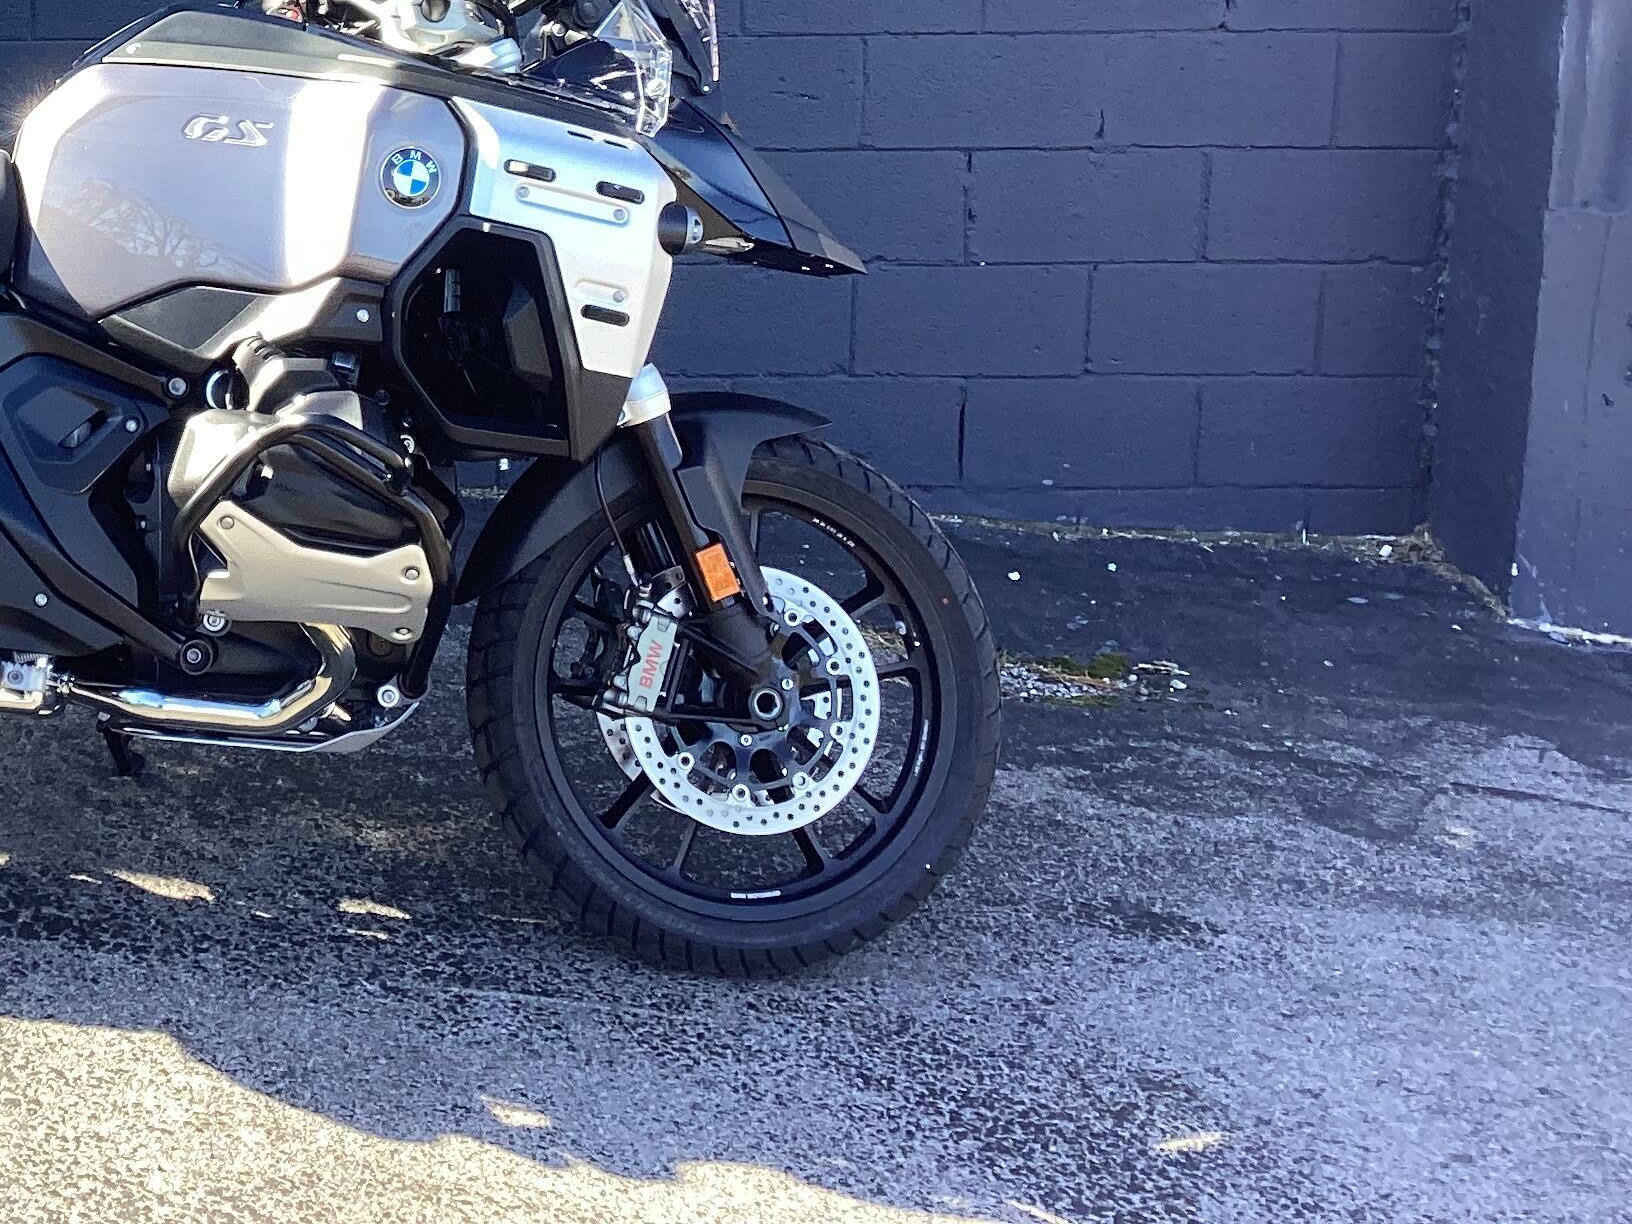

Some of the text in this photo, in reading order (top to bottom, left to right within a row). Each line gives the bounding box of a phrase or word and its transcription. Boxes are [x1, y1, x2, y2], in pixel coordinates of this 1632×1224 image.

[183, 114, 274, 147] GS
[391, 149, 437, 174] BMW
[639, 639, 663, 689] BMW
